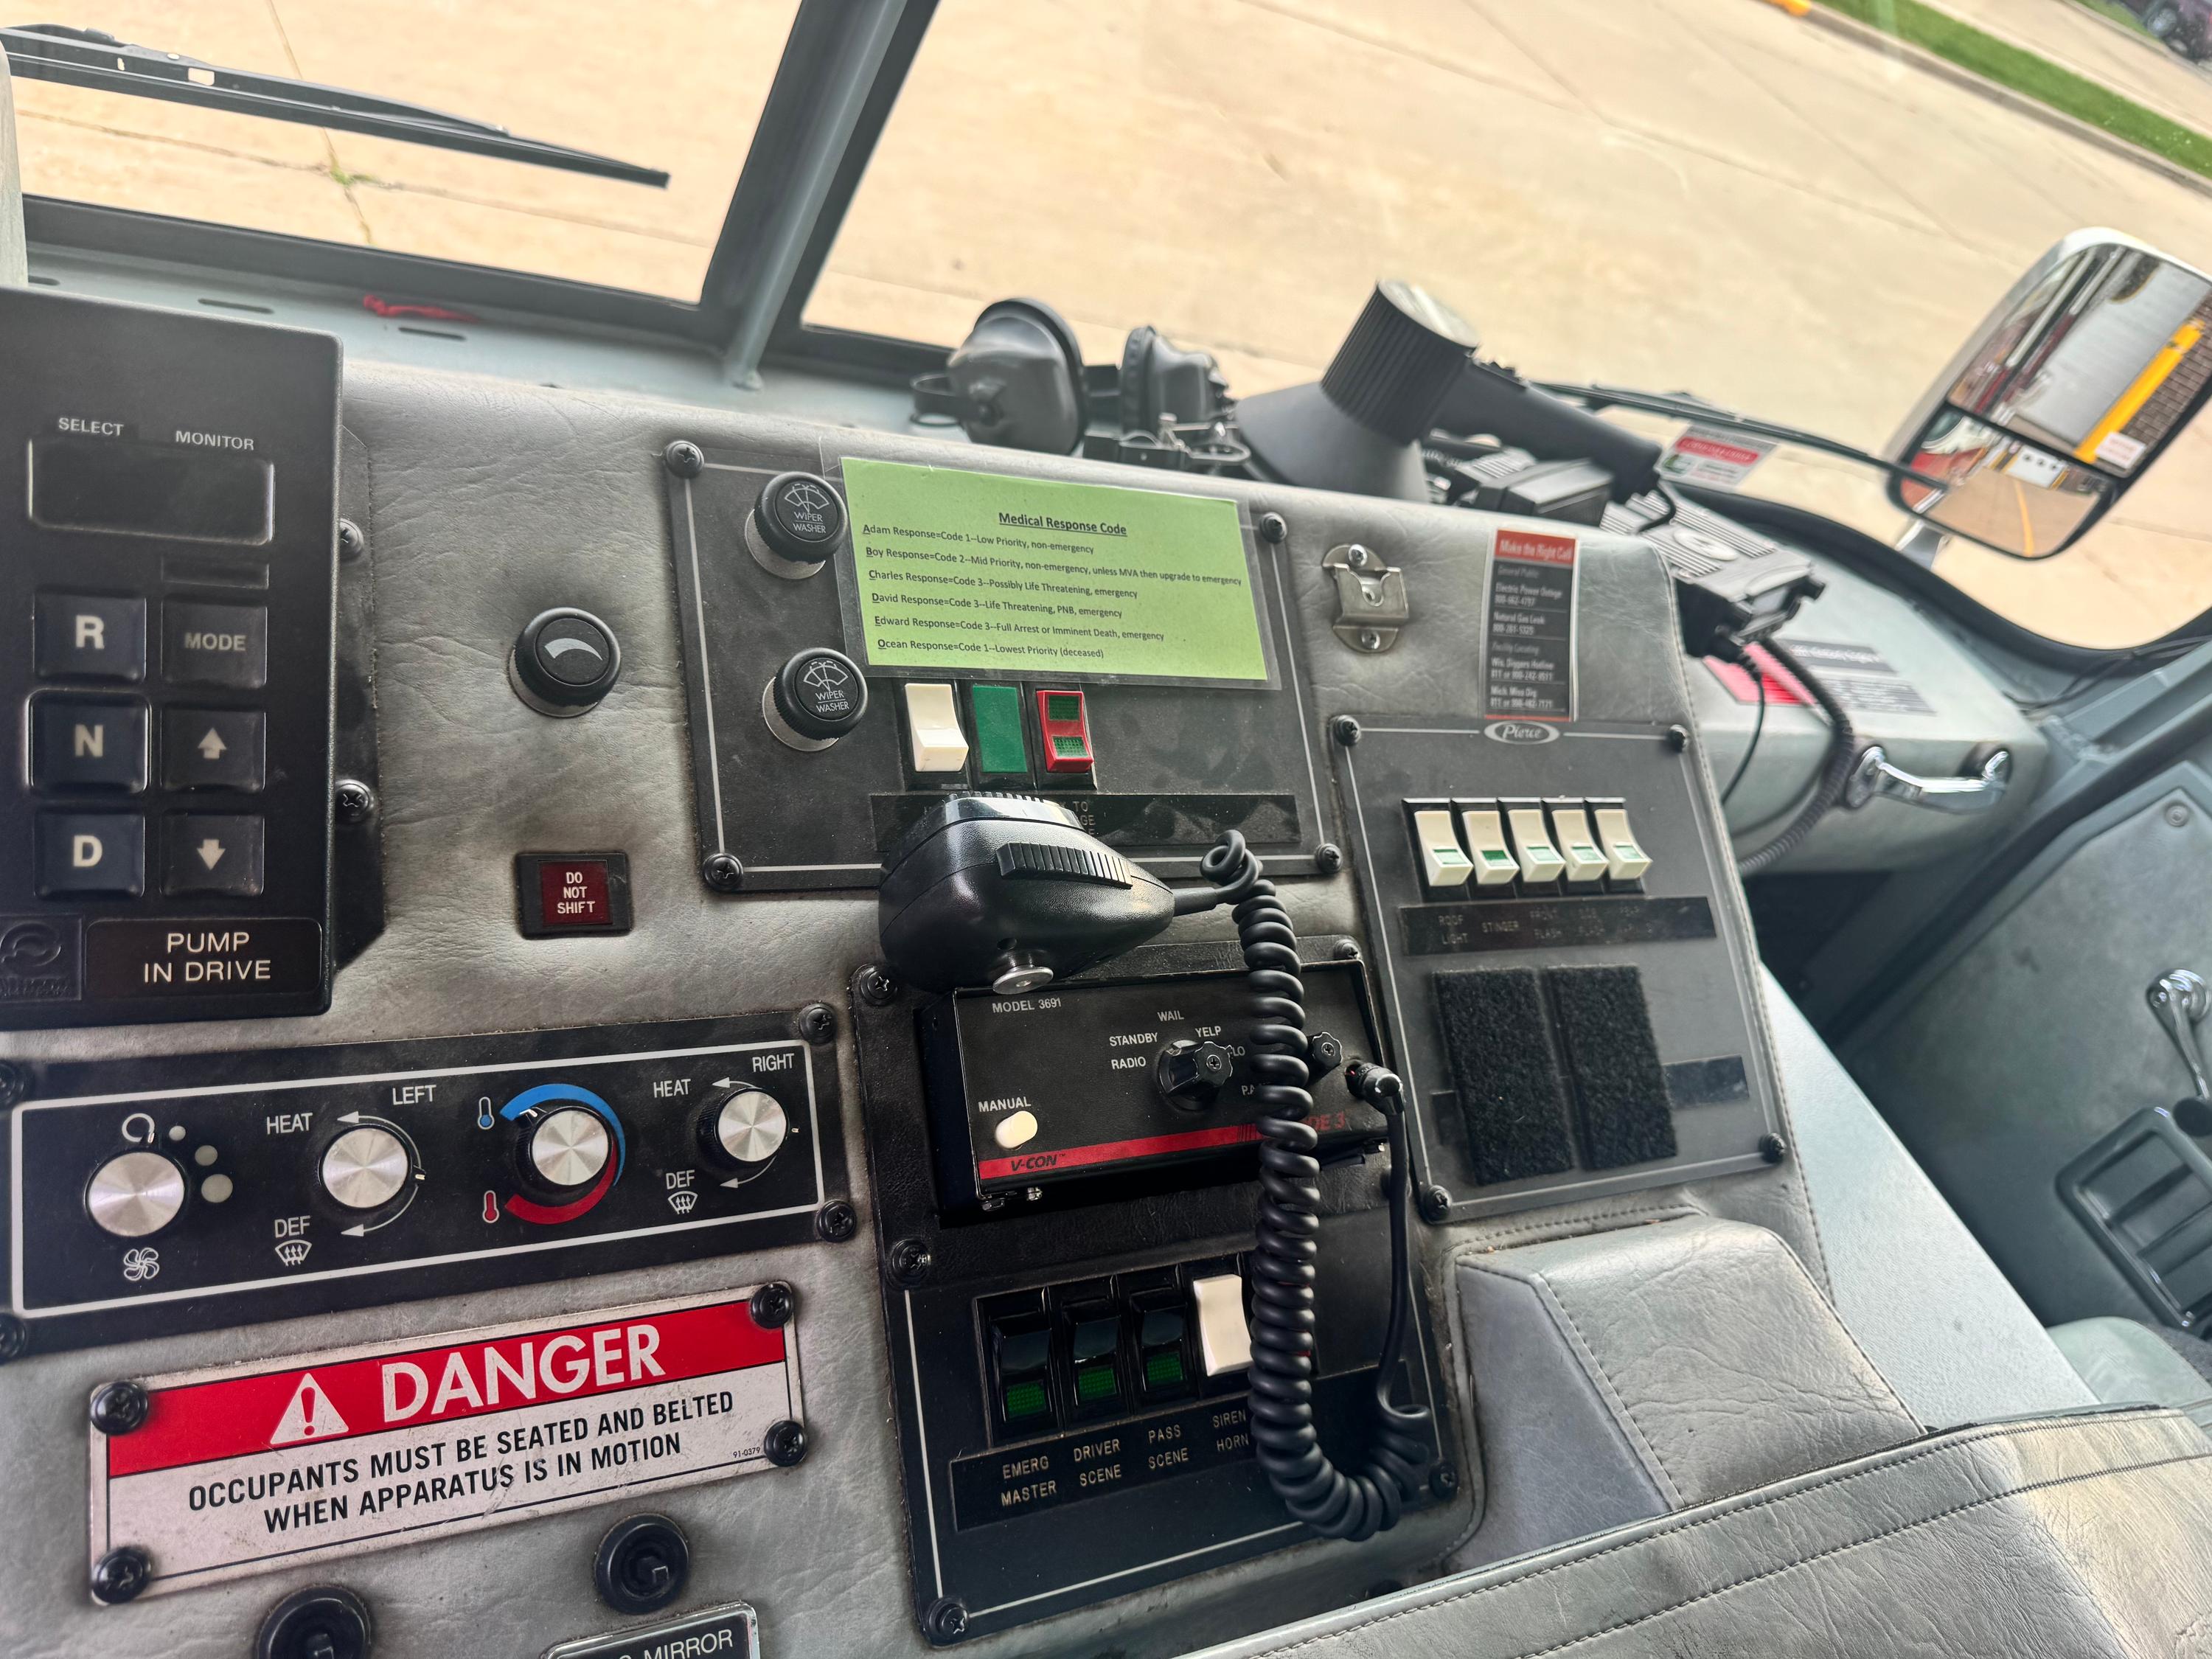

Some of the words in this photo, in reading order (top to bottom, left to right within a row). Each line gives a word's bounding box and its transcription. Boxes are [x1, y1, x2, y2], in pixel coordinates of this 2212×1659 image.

[58, 417, 125, 437] SELECT
[175, 430, 254, 451] MONITOR
[793, 512, 823, 523] WIPER
[998, 512, 1043, 528] Medical
[1046, 518, 1098, 532] Response
[1100, 522, 1128, 536] Code
[793, 523, 827, 534] WASHER
[863, 524, 891, 535] Adam
[893, 526, 963, 542] Response=Code
[997, 538, 1029, 550] Priority,
[1032, 540, 1094, 554] non-emergency
[1499, 540, 1522, 555] Make
[866, 547, 884, 558] Boy
[886, 549, 957, 563] Response=Code
[990, 558, 1023, 570] Priority,
[1025, 561, 1091, 575] non-emergency,
[1093, 566, 1118, 576] unless
[1119, 568, 1139, 577] MVA
[1140, 570, 1158, 580] then
[1160, 571, 1191, 582] upgrade
[1192, 574, 1200, 582] to
[1202, 576, 1242, 587] emergency
[869, 570, 903, 581] Charles
[905, 572, 975, 586] Response=Code
[1025, 582, 1040, 591] Life
[1042, 582, 1093, 597] Threatening,
[1094, 588, 1138, 599] emergency
[872, 593, 898, 603] David
[901, 594, 972, 608] Response=Code
[1003, 601, 1056, 615] Threatening,
[1057, 606, 1077, 616] PNB,
[1079, 608, 1122, 619] emergency
[75, 615, 105, 649] R
[874, 616, 910, 627] Edward
[912, 618, 983, 630] Response=Code
[1014, 625, 1040, 634] Arrest
[1052, 627, 1092, 637] Imminent
[1093, 628, 1121, 639] Death,
[1121, 631, 1164, 641] emergency
[184, 632, 246, 652] MODE
[877, 639, 908, 650] Ocean
[910, 640, 981, 653] Response=Code
[1027, 646, 1058, 657] Priority
[1060, 647, 1104, 658] (deceased)
[815, 689, 844, 701] WIPER
[815, 700, 849, 713] WASHER
[74, 725, 104, 758] N
[1503, 725, 1542, 741] Pierce
[1073, 801, 1089, 812] TO
[72, 835, 103, 867] D
[566, 872, 582, 884] DO
[563, 886, 588, 899] NOT
[557, 901, 596, 914] SHIFT
[167, 931, 250, 954] PUMP
[144, 962, 173, 984] IN
[185, 960, 271, 982] DRIVE
[992, 999, 1035, 1014] MODEL
[1038, 997, 1062, 1011] 3691
[1158, 1010, 1185, 1023] WAIL
[1109, 1032, 1159, 1048] STANDBY
[1195, 1025, 1222, 1039] YELP
[751, 1053, 795, 1074] RIGHT
[1110, 1056, 1147, 1071] RADIO
[392, 1085, 437, 1106] LEFT
[653, 1078, 692, 1099] HEAT
[978, 1096, 1032, 1113] MANUAL
[266, 1113, 313, 1134] HEAT
[665, 1169, 695, 1190] DEF
[274, 1215, 311, 1239] DEF
[381, 1324, 667, 1422] DANGER
[1211, 1409, 1247, 1429] SIREN
[1148, 1425, 1182, 1443] PASS
[1216, 1433, 1249, 1453] HORN
[189, 1457, 360, 1511] OCCUPANTS
[370, 1441, 446, 1479] MUST
[456, 1435, 487, 1463] BE
[497, 1417, 588, 1455] SEATED
[597, 1406, 644, 1436] AND
[653, 1391, 734, 1426] BELTED
[732, 1445, 761, 1459] 91-0379
[1073, 1438, 1121, 1463] DRIVER
[1147, 1447, 1189, 1470] SCENE
[1002, 1455, 1050, 1480] EMERG
[1079, 1463, 1122, 1487] SCENE
[264, 1495, 349, 1534] WHEN
[359, 1464, 513, 1516] APPARATUS
[525, 1458, 548, 1484] IS
[557, 1455, 582, 1477] IN
[591, 1432, 681, 1470] MOTION
[1000, 1479, 1057, 1507] MASTER
[644, 1628, 734, 1659] MIRROR
